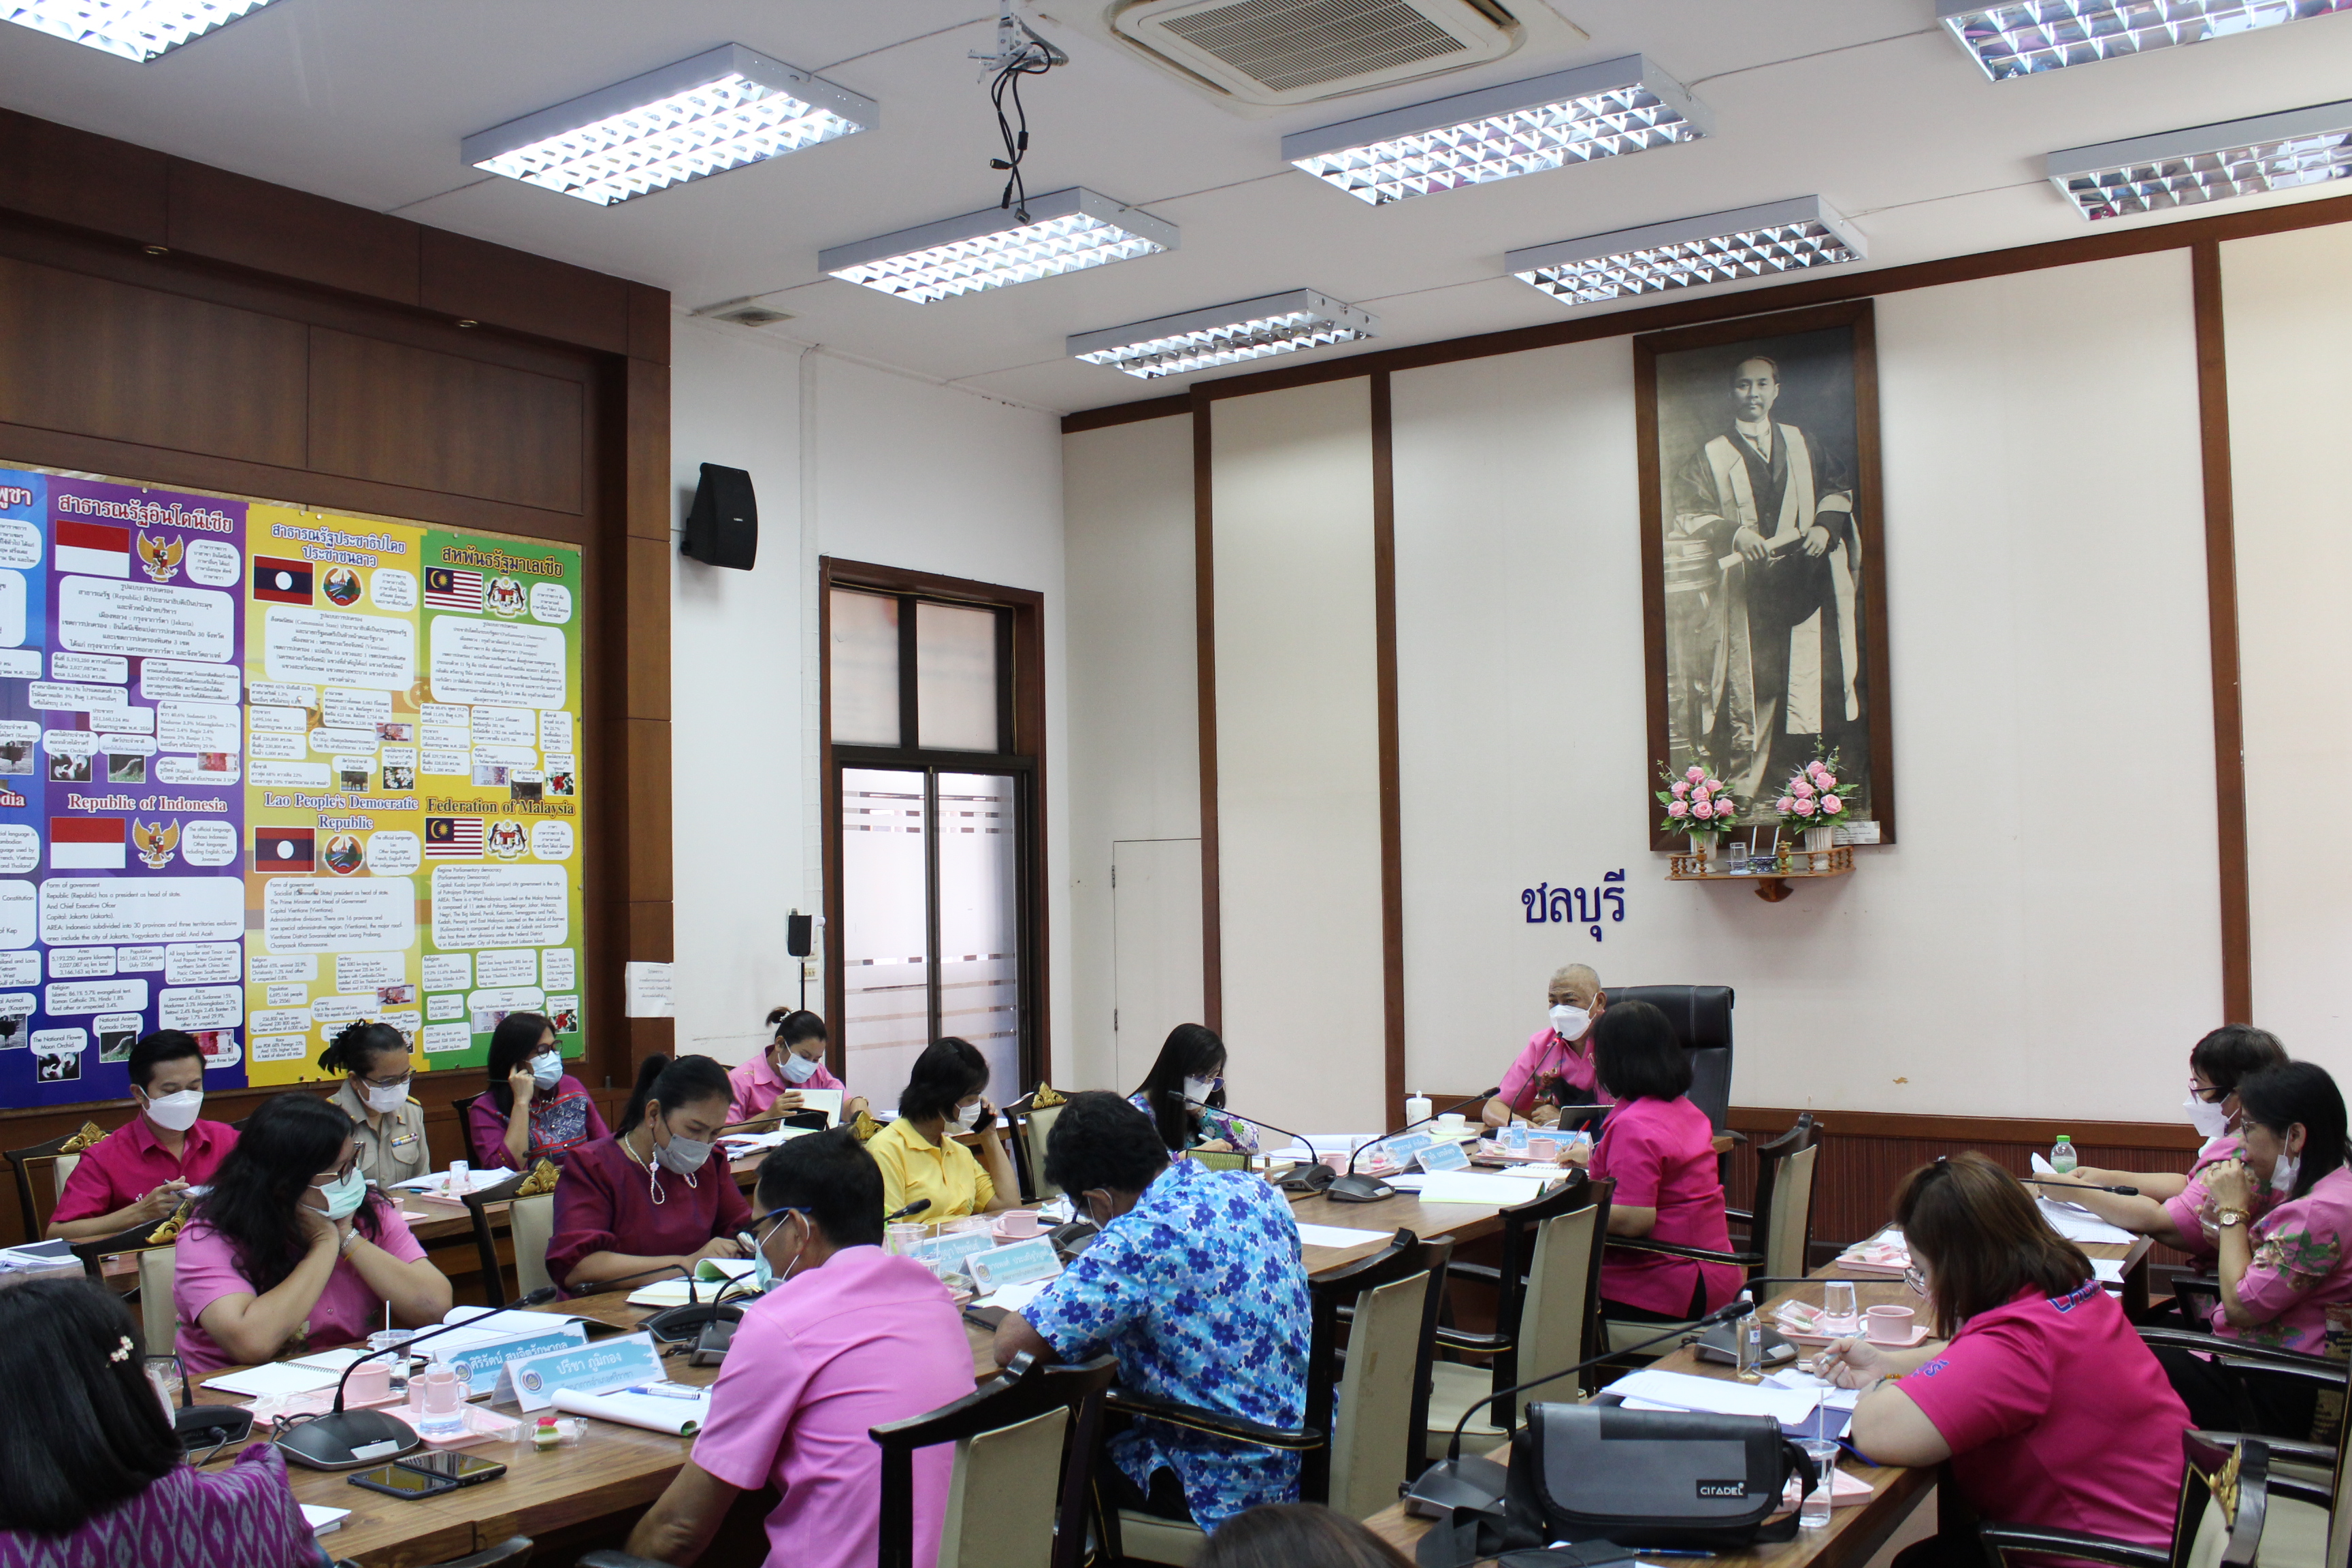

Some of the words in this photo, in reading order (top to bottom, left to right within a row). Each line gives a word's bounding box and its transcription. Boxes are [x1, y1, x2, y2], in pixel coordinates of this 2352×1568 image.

[59, 495, 233, 533] สาธารณรัฐอินโดนีเซีย
[272, 524, 406, 553] สาธารณรัฐประชาธิปไตย
[303, 544, 377, 566] ประชาชนลาว
[442, 545, 563, 576] สหพันธรัฐมาเลเซีย
[68, 794, 136, 813] Republic
[140, 797, 156, 811] of
[159, 797, 228, 812] Indonesia
[264, 792, 291, 807] Lao
[348, 794, 419, 810] Democratic
[427, 797, 498, 813] Federation
[502, 799, 517, 814] of
[519, 799, 576, 817] Malaysia
[318, 815, 374, 832] Republic
[1521, 868, 1625, 942] ชลบุรี
[556, 1358, 585, 1374] ปรีชา
[588, 1352, 622, 1372] ภูมิกอง
[1699, 1486, 1744, 1495] CITADEL
